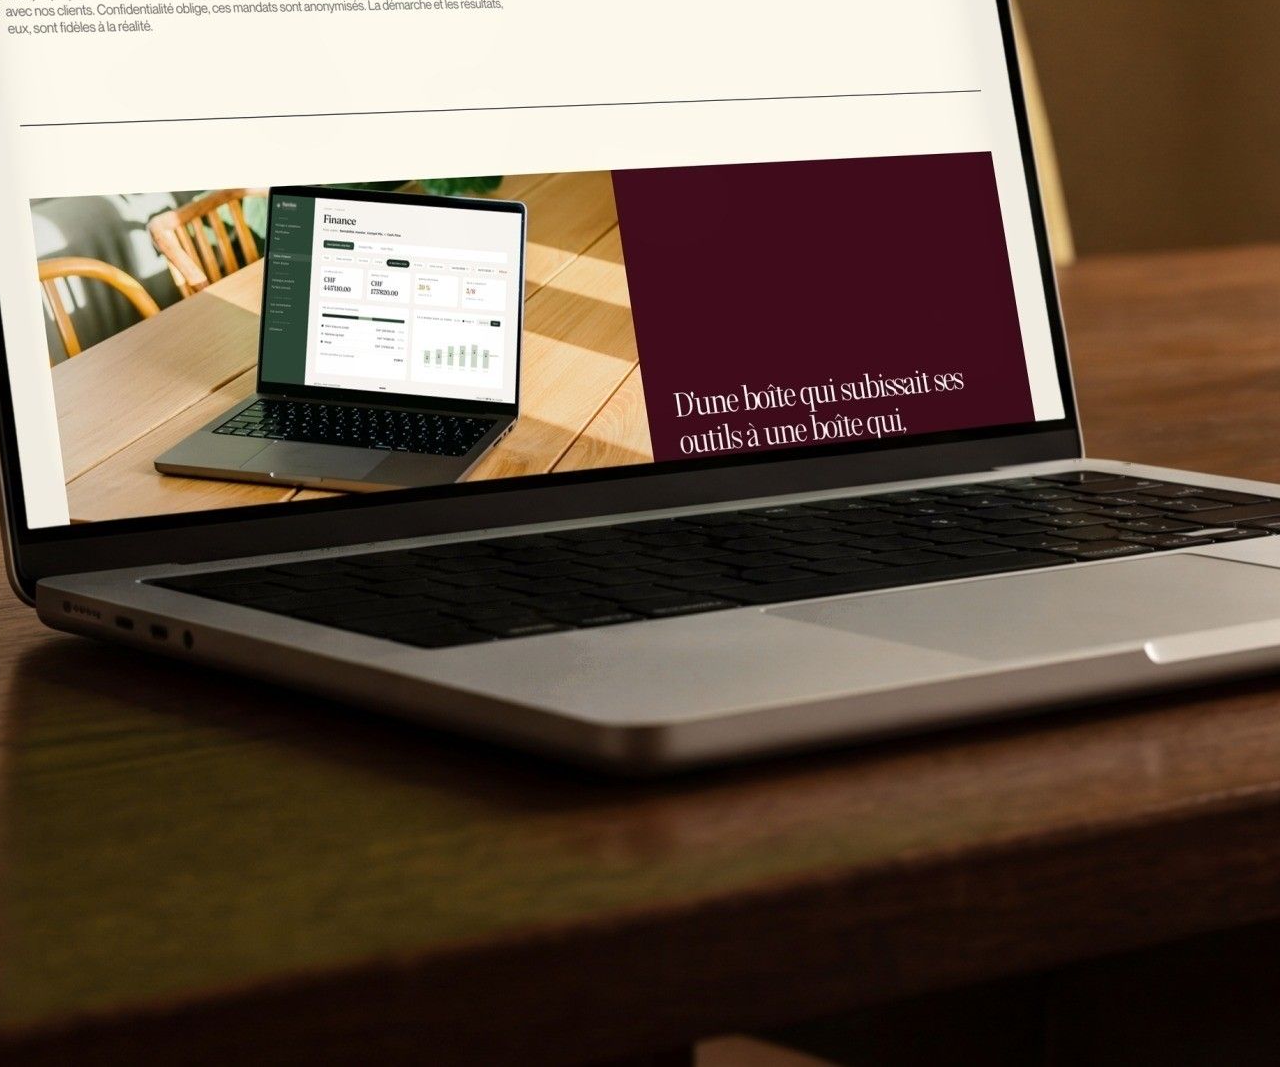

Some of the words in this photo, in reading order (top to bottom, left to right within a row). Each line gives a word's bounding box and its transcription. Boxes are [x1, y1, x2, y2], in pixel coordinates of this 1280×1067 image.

[6, 8, 32, 17] avec
[35, 8, 55, 16] nos
[57, 5, 94, 16] clients.
[97, 3, 174, 15] Confidentialité
[176, 3, 210, 16] oblige,
[212, 5, 231, 13] ces
[233, 2, 278, 13] mandats
[280, 2, 302, 12] sont
[304, 0, 366, 13] anonymisés.
[368, 0, 381, 10] La
[383, 0, 432, 10] démarche
[434, 0, 443, 9] et
[445, 0, 459, 9] les
[461, 0, 503, 11] résultats,
[8, 26, 31, 35] eux,
[33, 22, 58, 33] sont
[60, 21, 96, 32] fidèles
[98, 21, 105, 32] à
[107, 21, 116, 32] la
[118, 20, 152, 31] réalité.
[323, 214, 357, 226] Finance
[674, 392, 738, 417] D'une
[741, 384, 796, 410] boîte
[800, 378, 839, 412] qui
[841, 371, 931, 400] subissait
[934, 373, 964, 391] ses
[680, 423, 743, 454] outils
[747, 423, 760, 447] à
[764, 424, 807, 445] une
[809, 414, 863, 440] boîte
[867, 408, 906, 438] qui,
